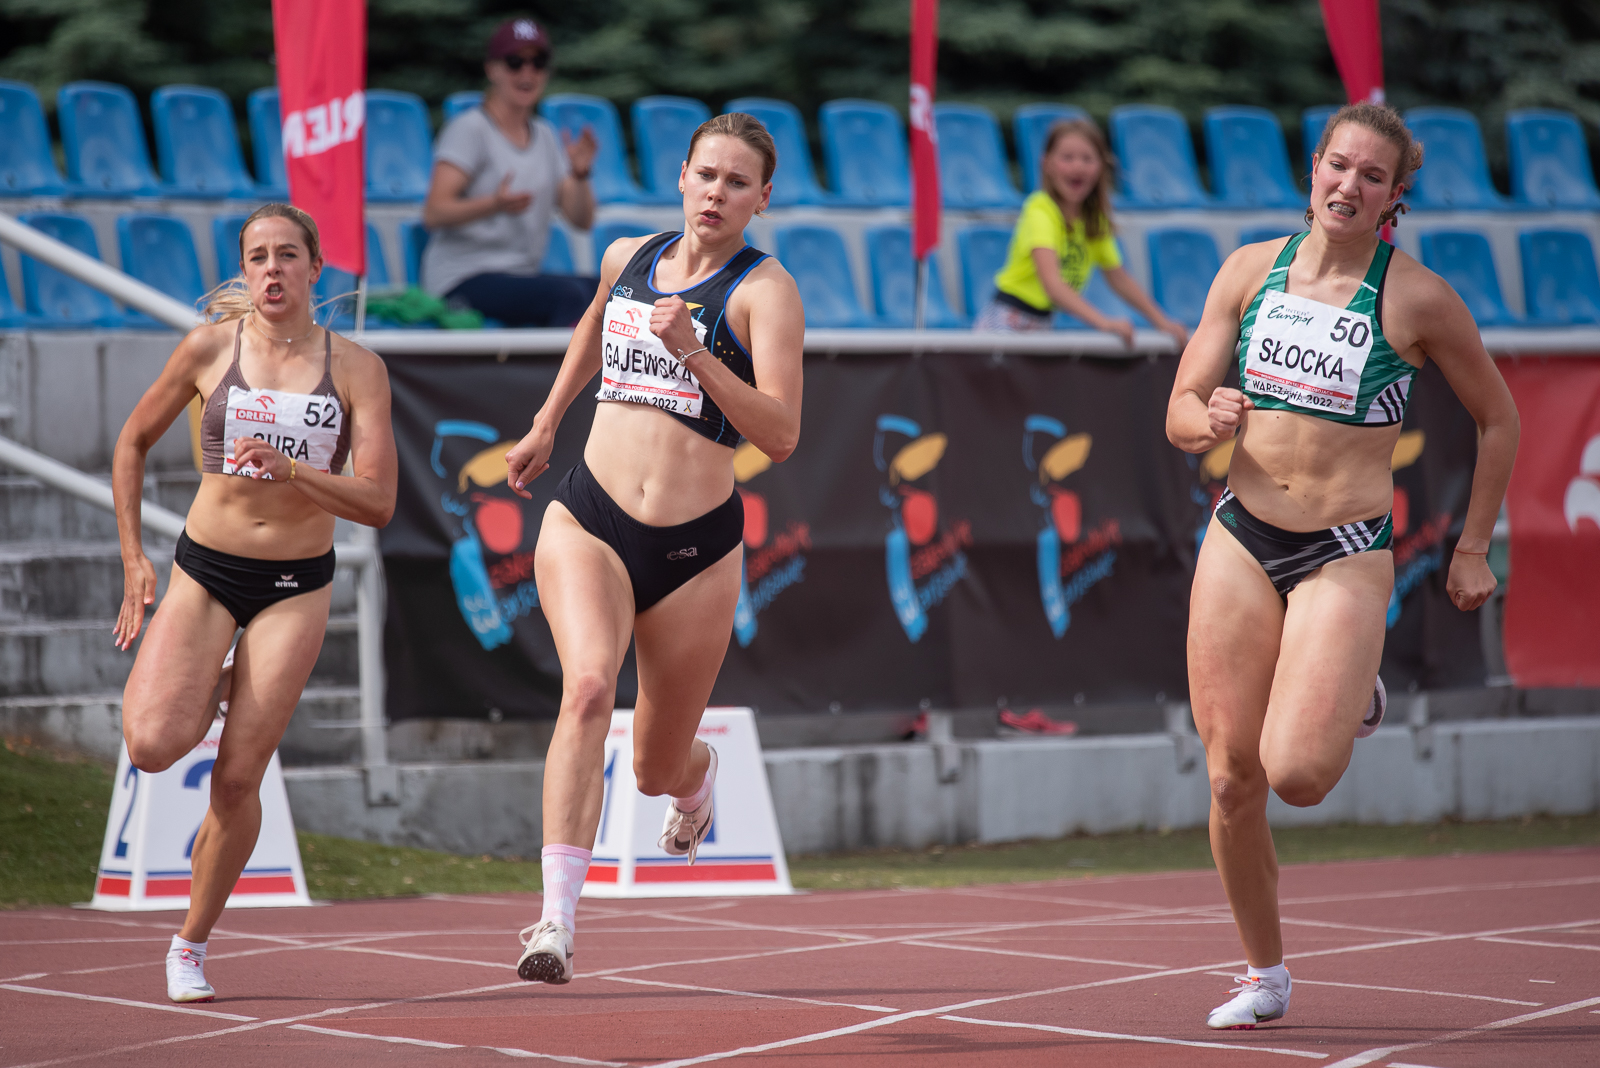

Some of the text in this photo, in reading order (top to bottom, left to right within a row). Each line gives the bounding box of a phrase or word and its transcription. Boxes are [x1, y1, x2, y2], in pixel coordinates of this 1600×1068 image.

[610, 321, 638, 338] ORLEN
[1330, 316, 1369, 348] 50
[605, 342, 693, 386] GAJEWSKA
[1259, 338, 1343, 382] SŁOCKA
[652, 397, 678, 411] 2022
[1306, 394, 1333, 408] 2022
[237, 410, 273, 422] ORLEN
[303, 402, 336, 428] 52
[666, 546, 698, 561] esa
[114, 762, 139, 859] 2
